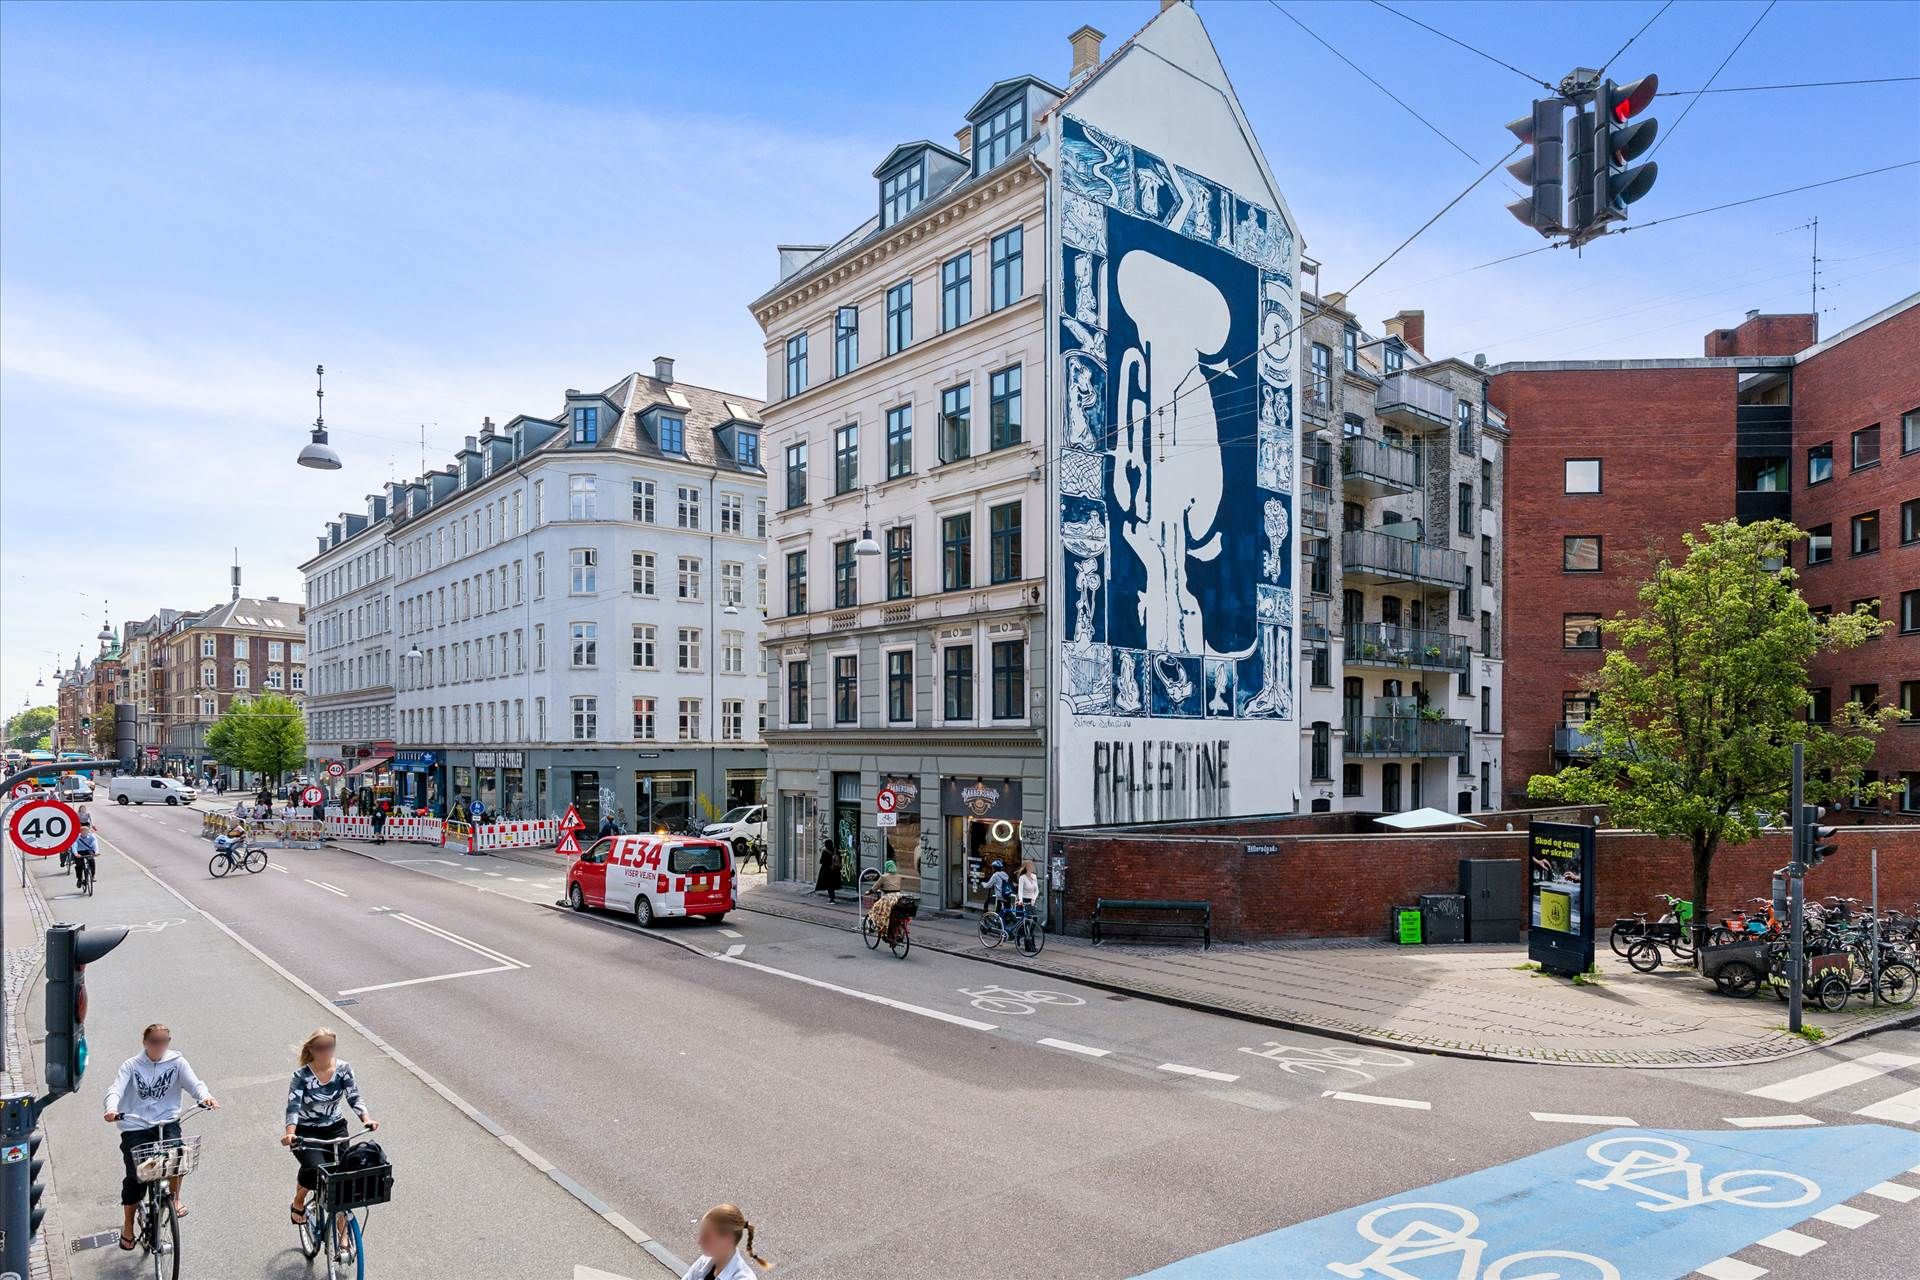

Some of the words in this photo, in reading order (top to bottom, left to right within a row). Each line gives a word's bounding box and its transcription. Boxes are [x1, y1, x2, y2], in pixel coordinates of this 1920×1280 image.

[21, 816, 67, 838] 40
[1535, 836, 1552, 846] Skod
[1553, 839, 1562, 849] og
[607, 839, 663, 870] LE34
[1551, 848, 1573, 858] skrald
[624, 869, 640, 877] VISER
[640, 870, 656, 881] VEJEN
